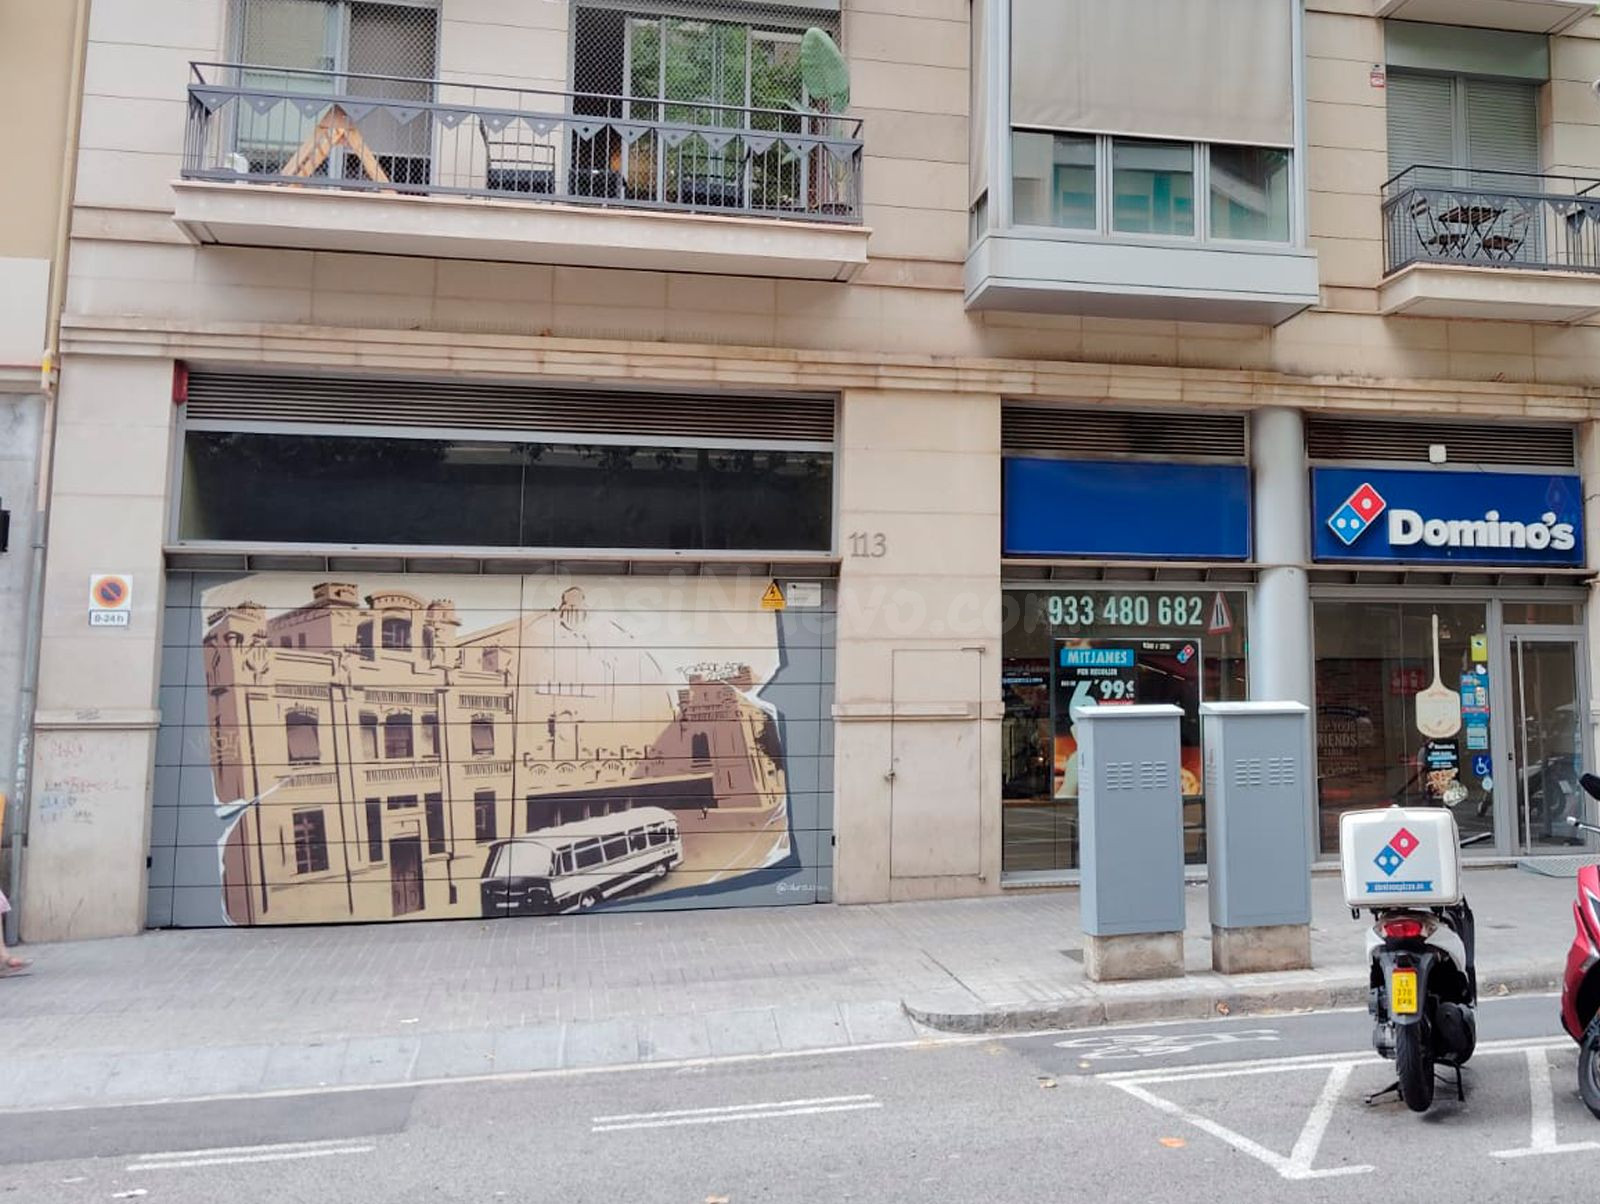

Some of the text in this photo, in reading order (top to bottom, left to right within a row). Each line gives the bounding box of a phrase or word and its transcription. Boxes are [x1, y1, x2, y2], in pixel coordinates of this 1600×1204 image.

[849, 532, 887, 558] 113
[1388, 509, 1574, 550] Domino's
[1048, 595, 1203, 627] 933 480 682
